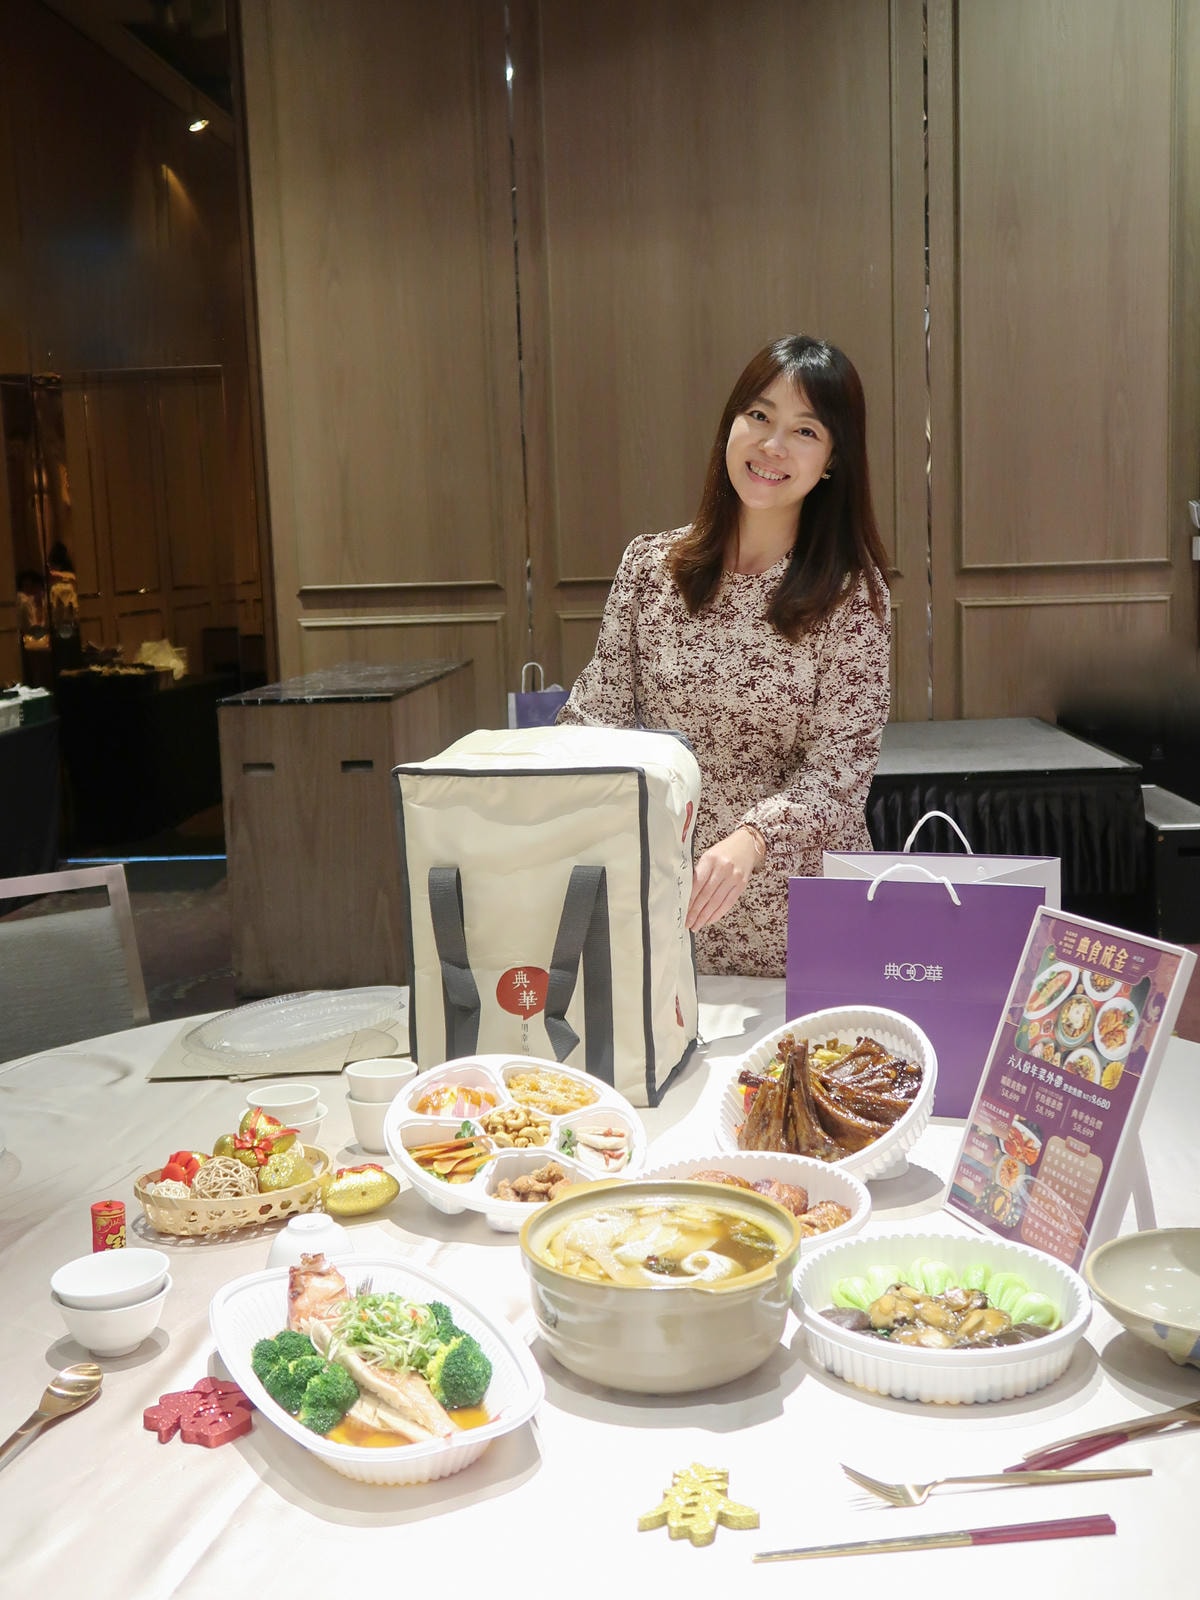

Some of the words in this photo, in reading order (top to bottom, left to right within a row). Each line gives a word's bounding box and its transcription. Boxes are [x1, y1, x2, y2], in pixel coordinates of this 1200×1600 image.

[1075, 936, 1129, 973] 典食成金
[512, 971, 538, 1010] 典華
